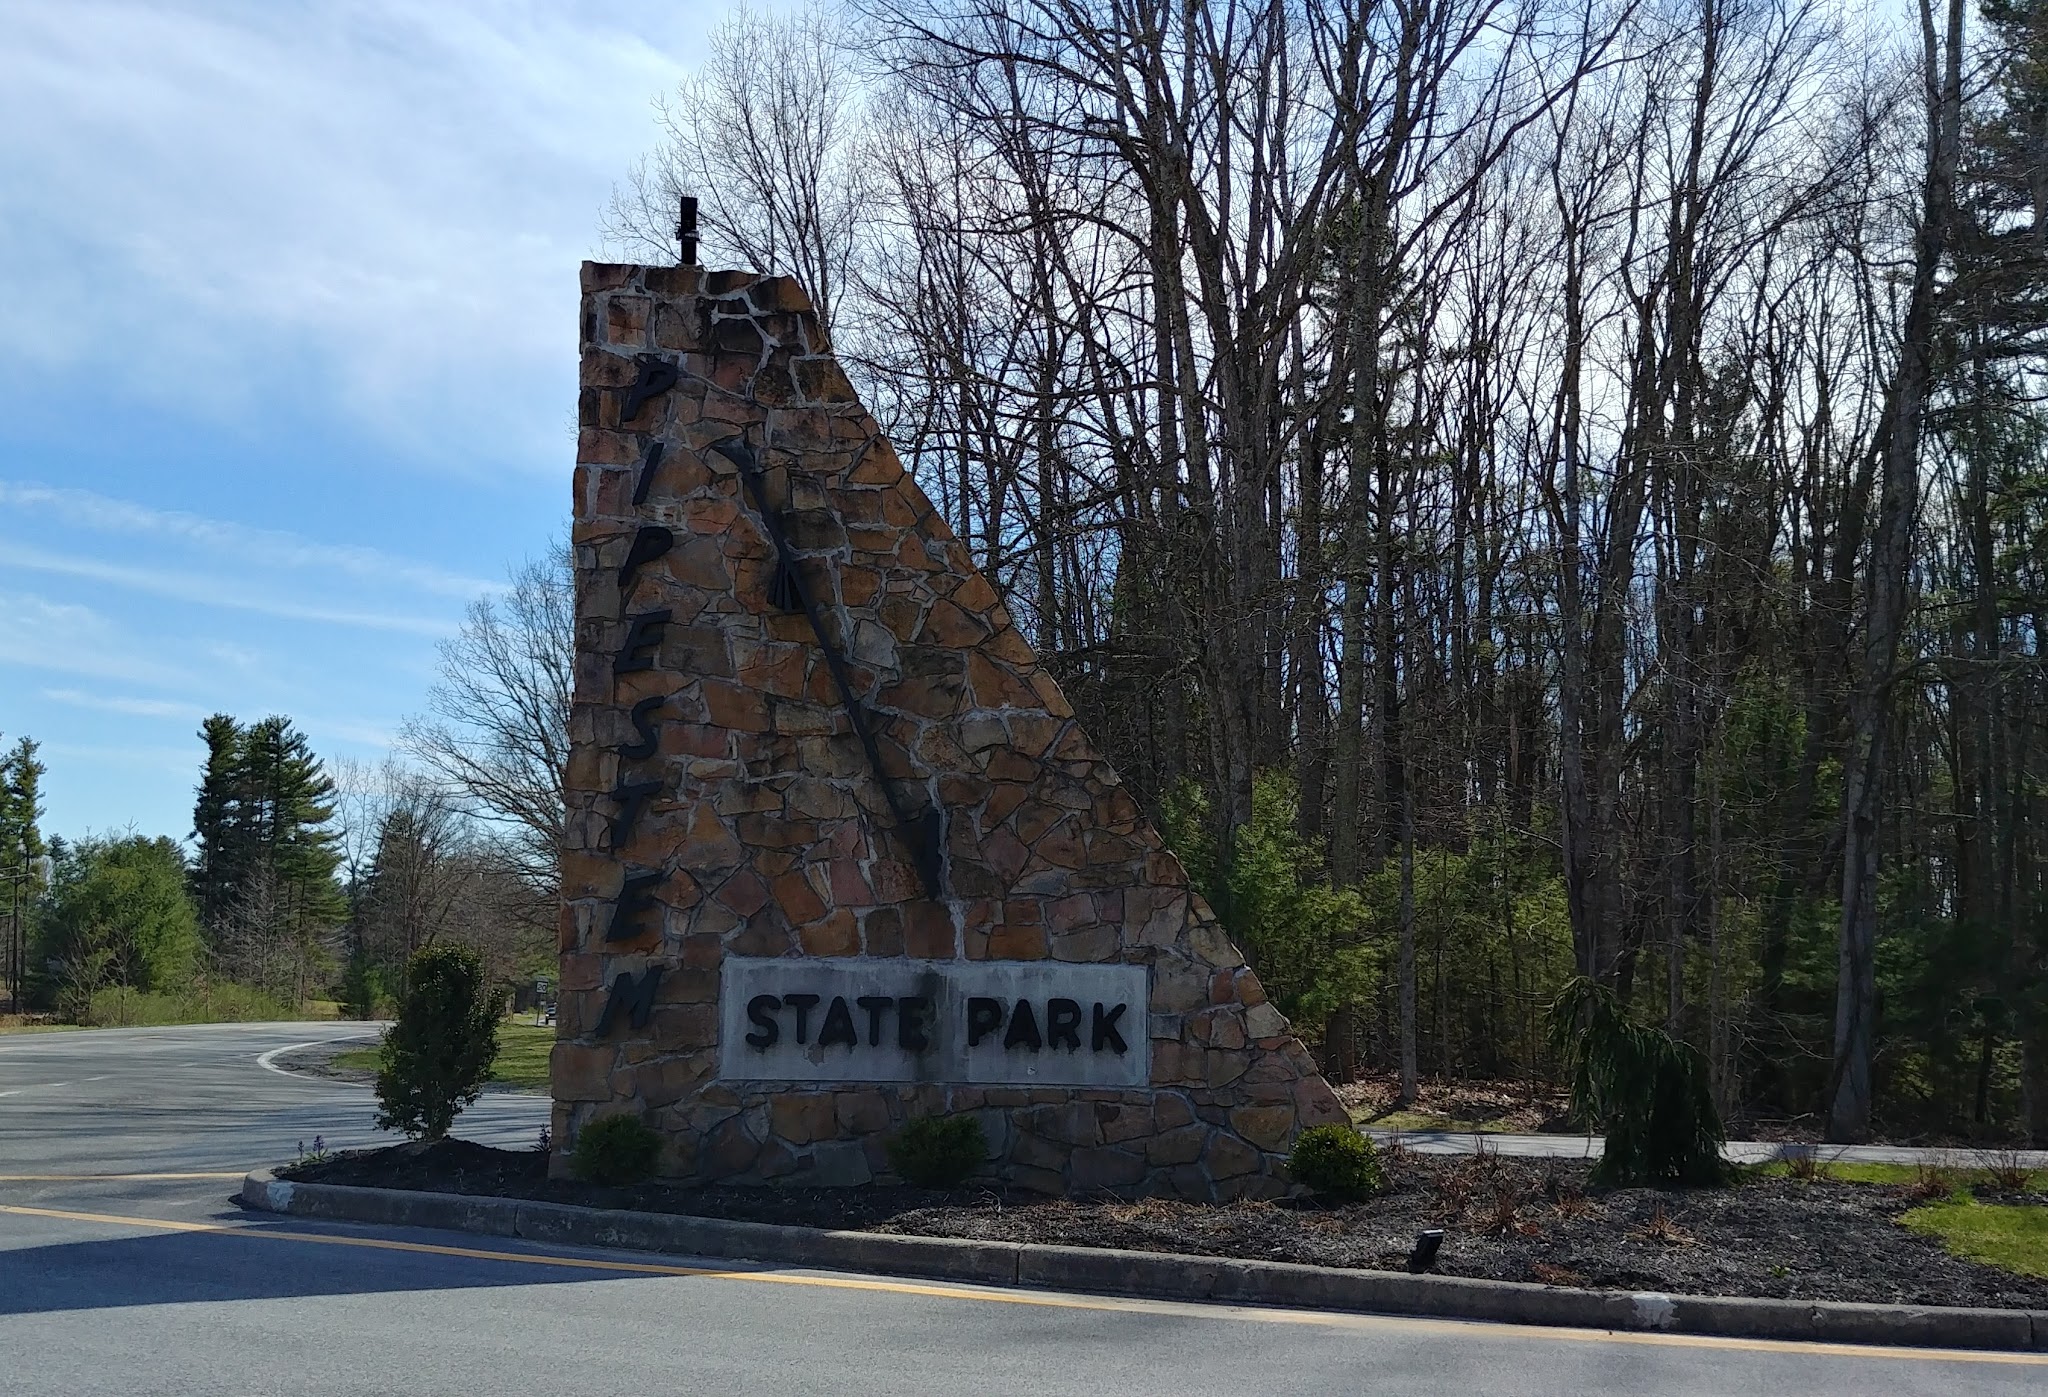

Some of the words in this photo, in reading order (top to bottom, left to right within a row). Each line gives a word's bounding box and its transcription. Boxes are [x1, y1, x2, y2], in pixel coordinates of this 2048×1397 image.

[597, 356, 677, 1037] PIPESTEM
[746, 994, 929, 1049] STATE
[967, 997, 1127, 1053] PARK
